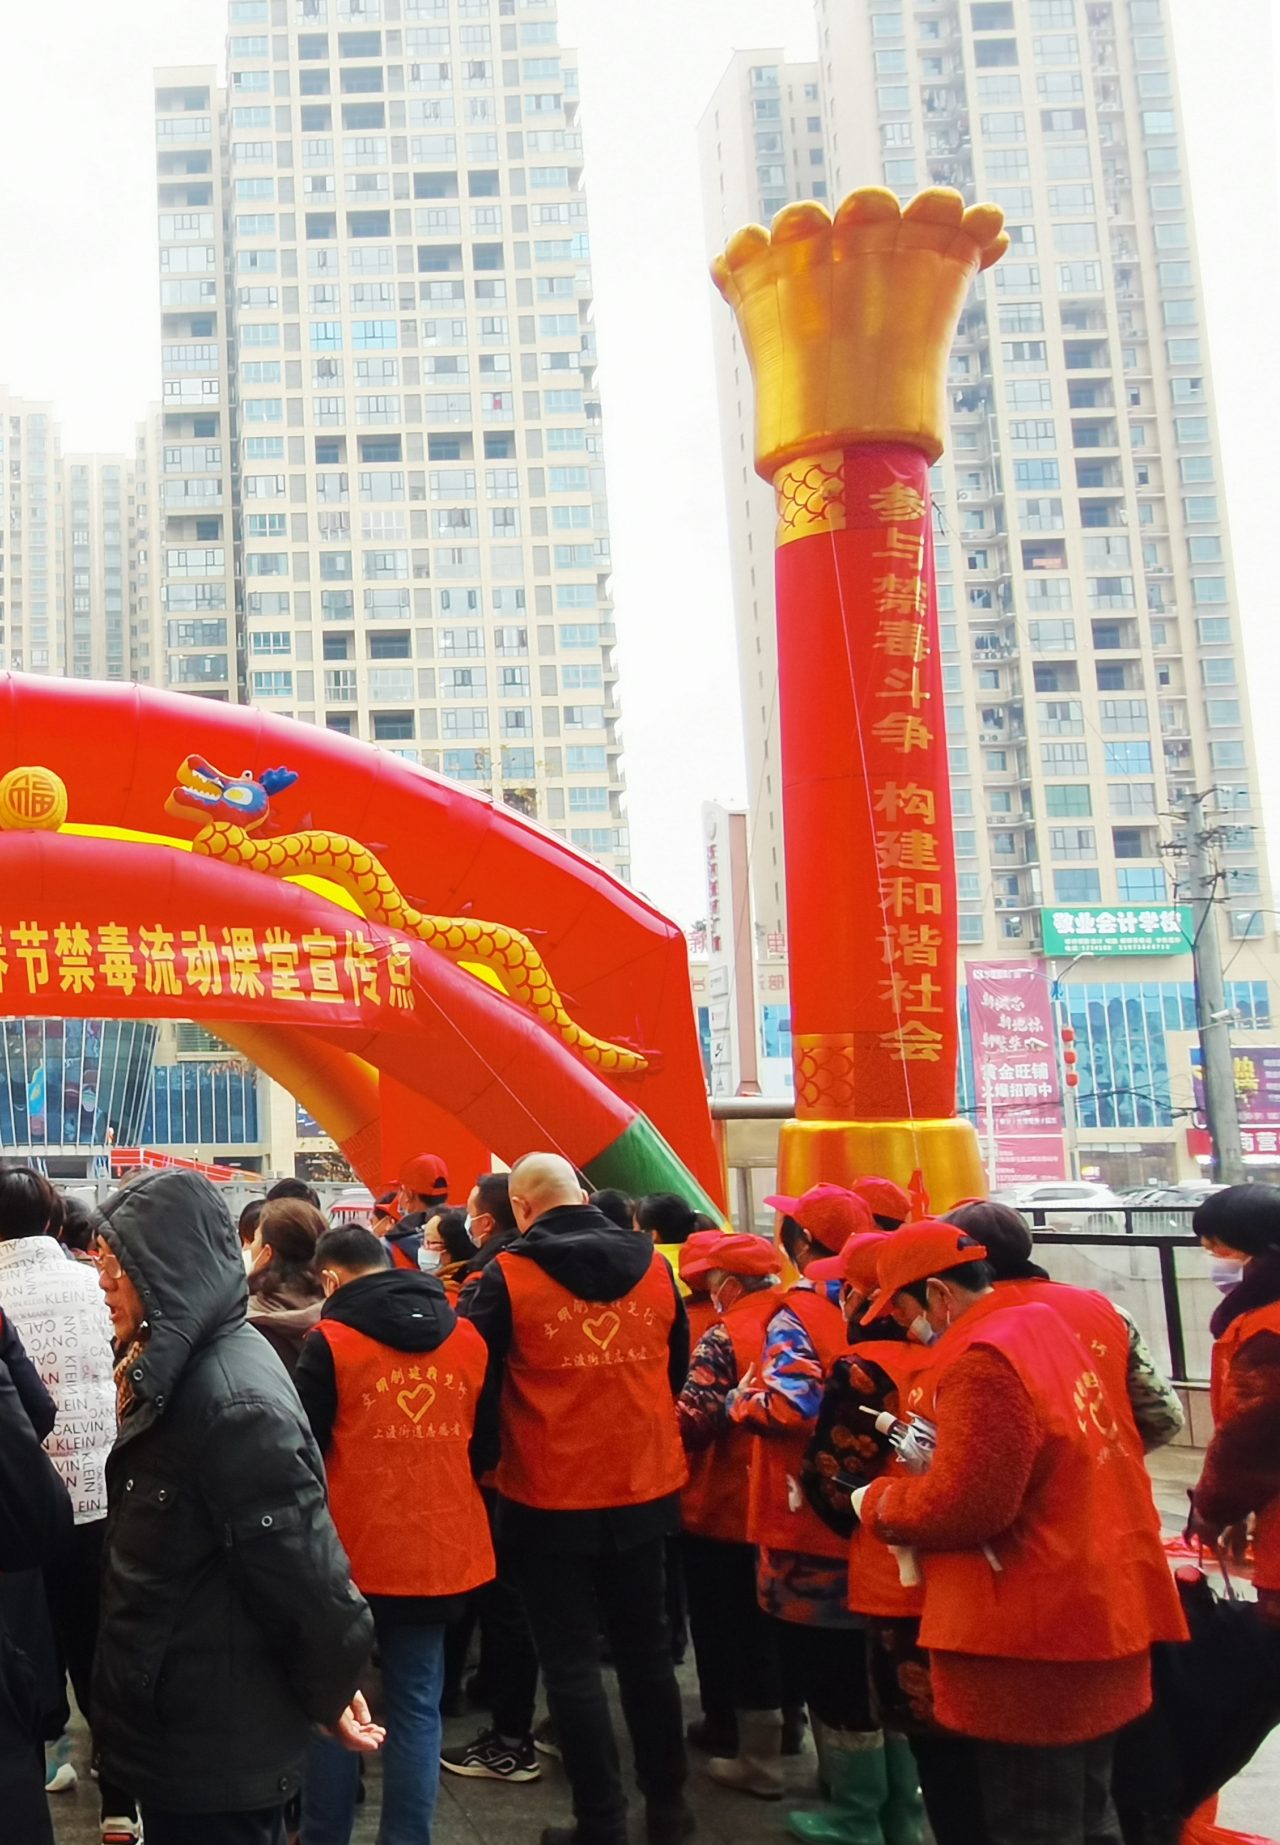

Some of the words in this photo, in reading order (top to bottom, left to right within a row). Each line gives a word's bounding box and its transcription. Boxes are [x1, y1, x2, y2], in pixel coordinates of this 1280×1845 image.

[869, 481, 934, 754] 参与禁毒斗争
[872, 781, 944, 1062] 构建和谐社会
[1052, 911, 1182, 934] 敬业会计学校
[981, 1062, 1049, 1081] 黄金旺铺
[45, 1291, 85, 1305] KLEIN
[52, 1421, 104, 1436] CALVIN
[57, 1436, 96, 1451] KLEIN
[81, 1451, 96, 1493] KLEIN
